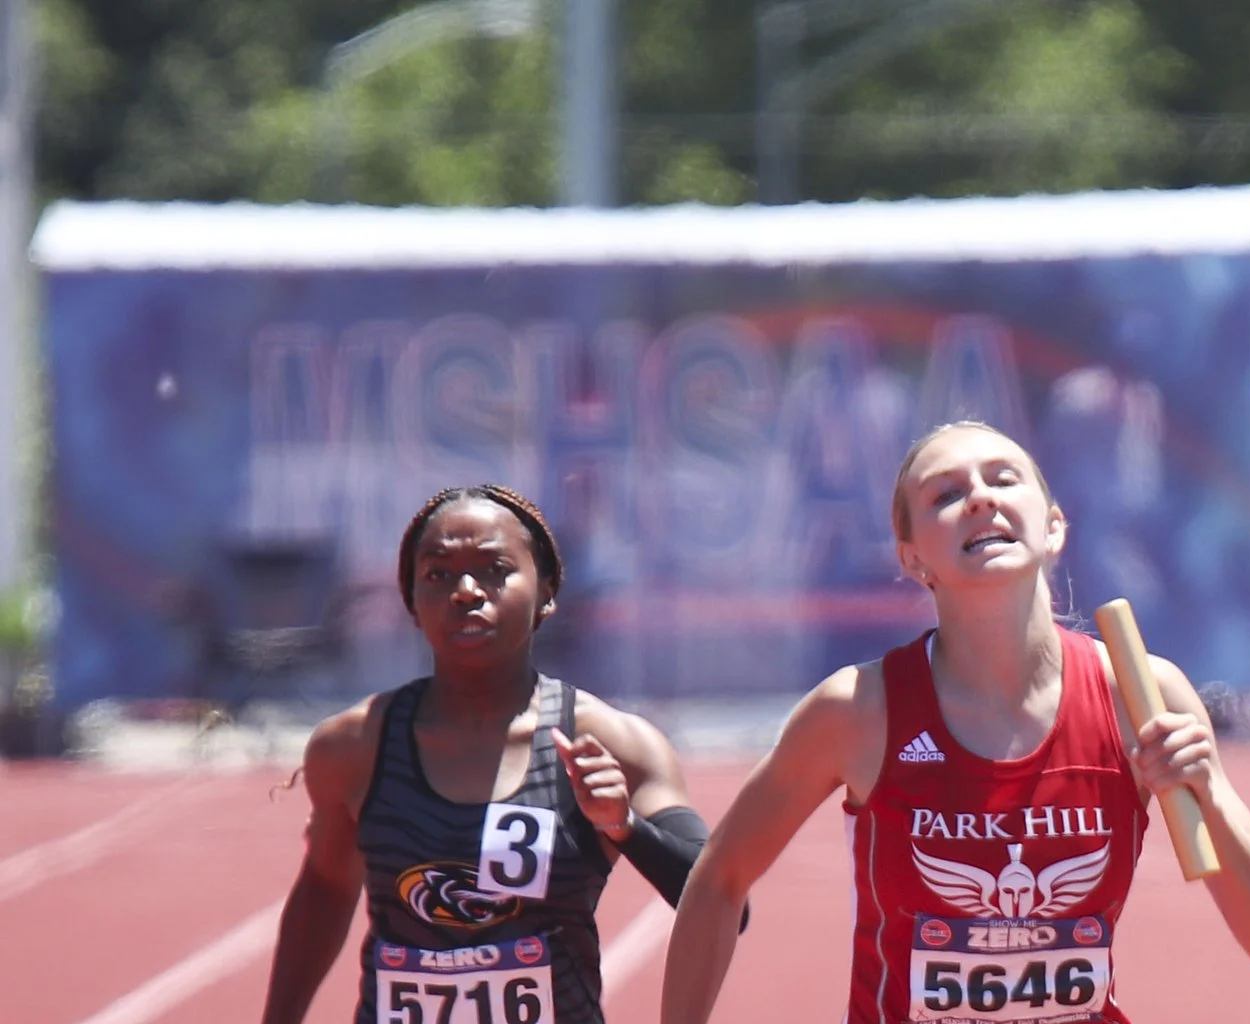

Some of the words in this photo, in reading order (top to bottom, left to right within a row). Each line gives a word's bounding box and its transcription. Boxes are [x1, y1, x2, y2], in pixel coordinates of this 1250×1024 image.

[898, 750, 946, 762] adidas
[910, 807, 1014, 840] PARK
[1023, 805, 1112, 838] HILL
[488, 811, 541, 888] 3
[967, 926, 1057, 948] ZERO
[419, 945, 500, 968] ZERO
[923, 957, 1096, 1013] 5646
